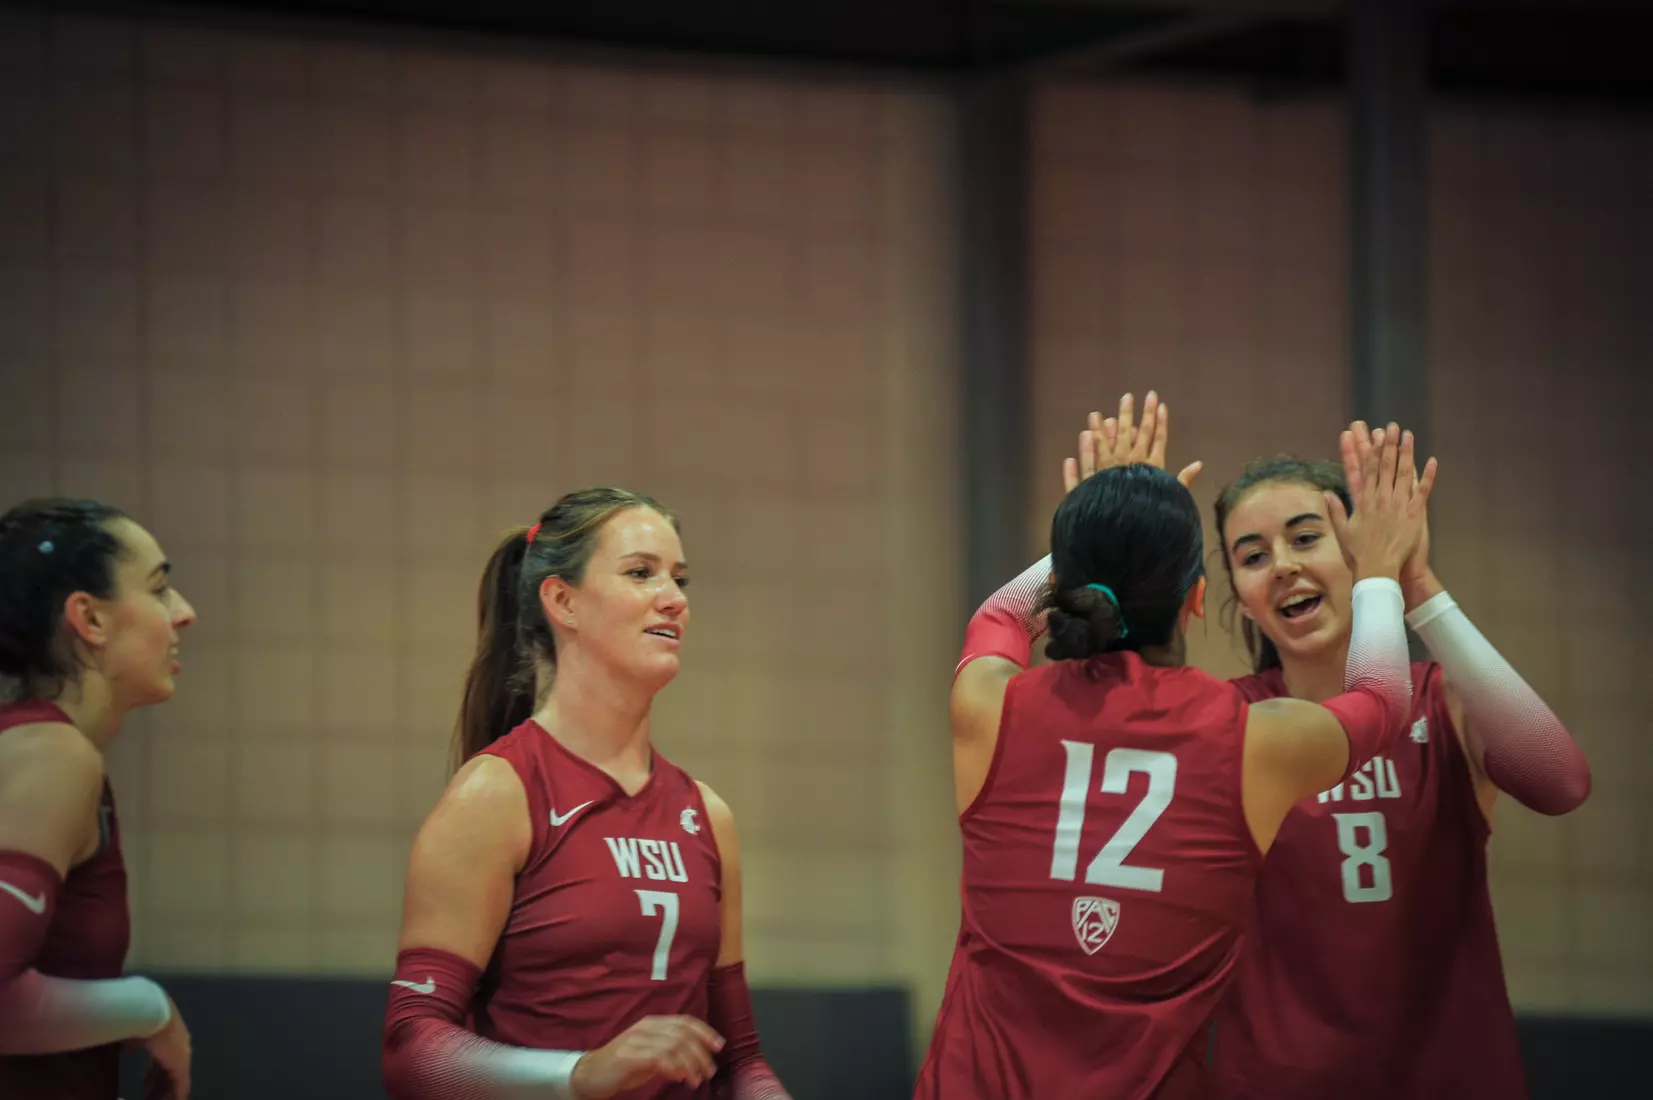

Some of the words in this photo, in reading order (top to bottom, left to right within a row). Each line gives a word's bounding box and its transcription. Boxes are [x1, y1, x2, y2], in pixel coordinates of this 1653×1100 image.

[1050, 739, 1178, 892] 12
[603, 837, 688, 882] WSU
[1331, 812, 1393, 903] 8
[634, 889, 680, 981] 7
[1076, 900, 1118, 933] PAC
[1081, 920, 1105, 943] 12
